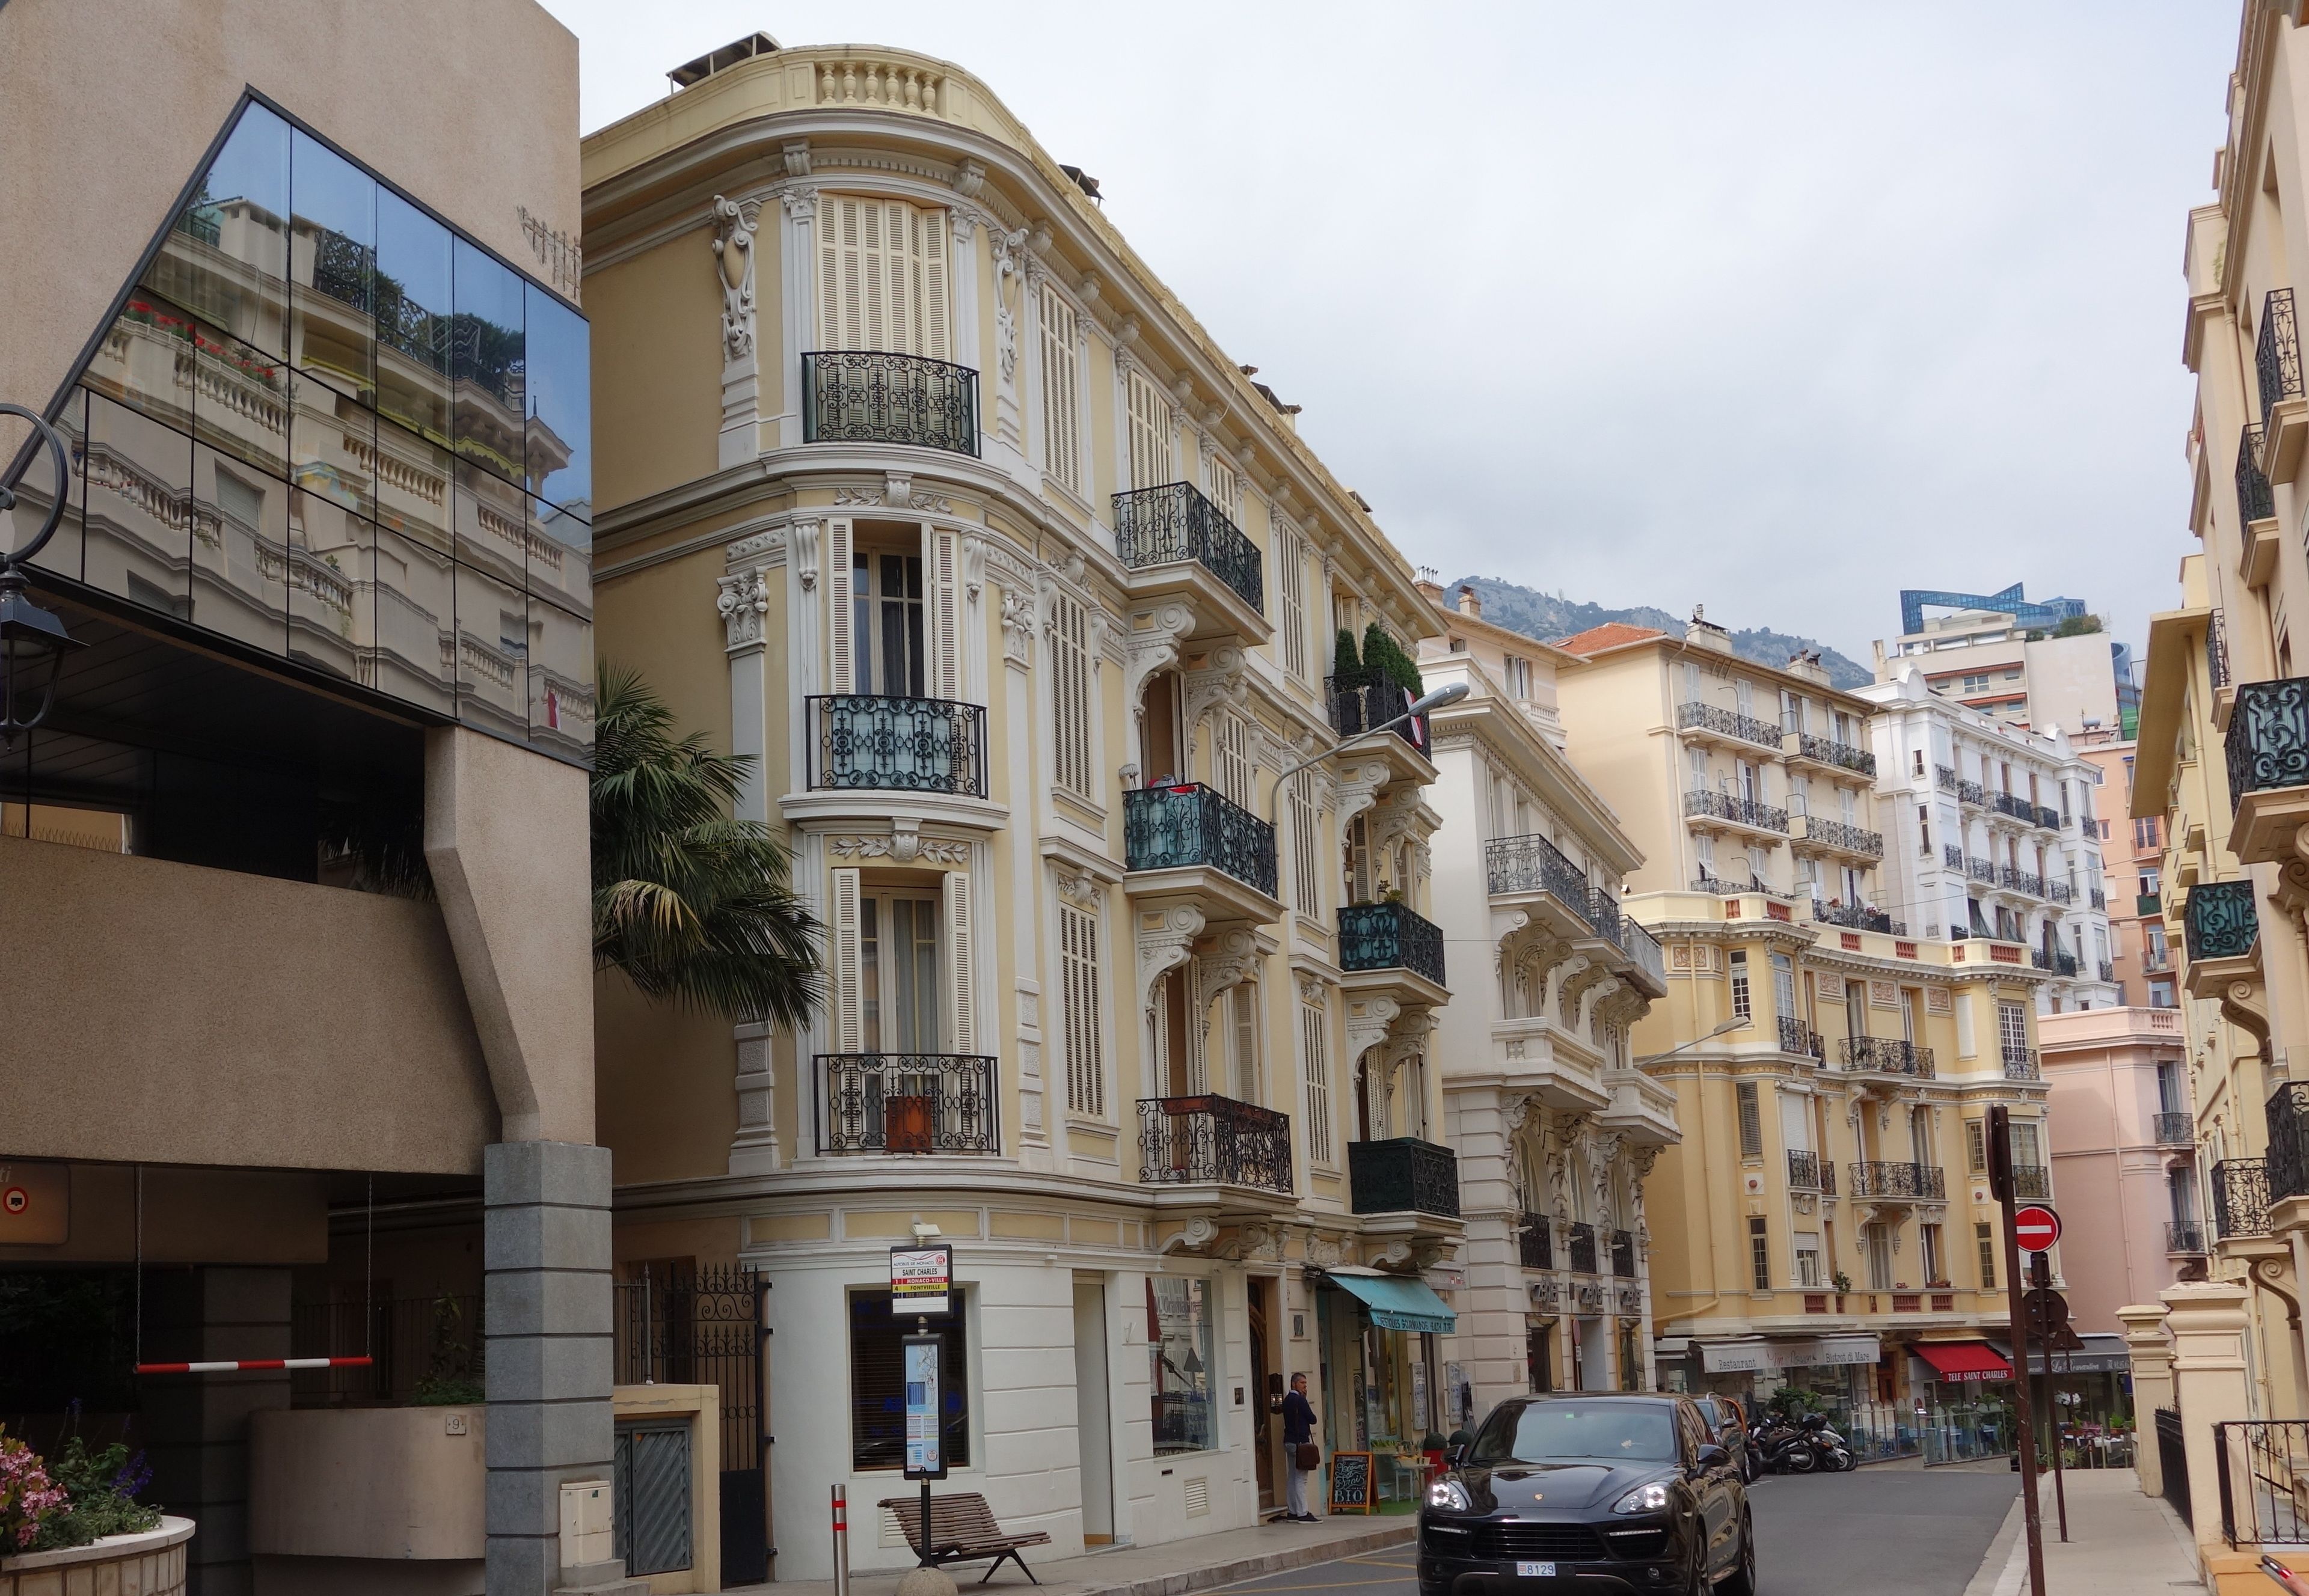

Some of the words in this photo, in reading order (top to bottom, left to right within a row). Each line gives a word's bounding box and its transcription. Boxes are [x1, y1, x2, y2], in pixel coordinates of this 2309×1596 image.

[1718, 1357, 1756, 1370] Restaurant
[1826, 1353, 1846, 1363] Bistrot
[1854, 1351, 1870, 1362] Mare
[1948, 1373, 1961, 1381] TELE
[1964, 1372, 1981, 1380] SAINT
[1982, 1370, 2008, 1379] CHARLES
[1334, 1490, 1363, 1502] BIO
[1527, 1565, 1554, 1575] 8129
